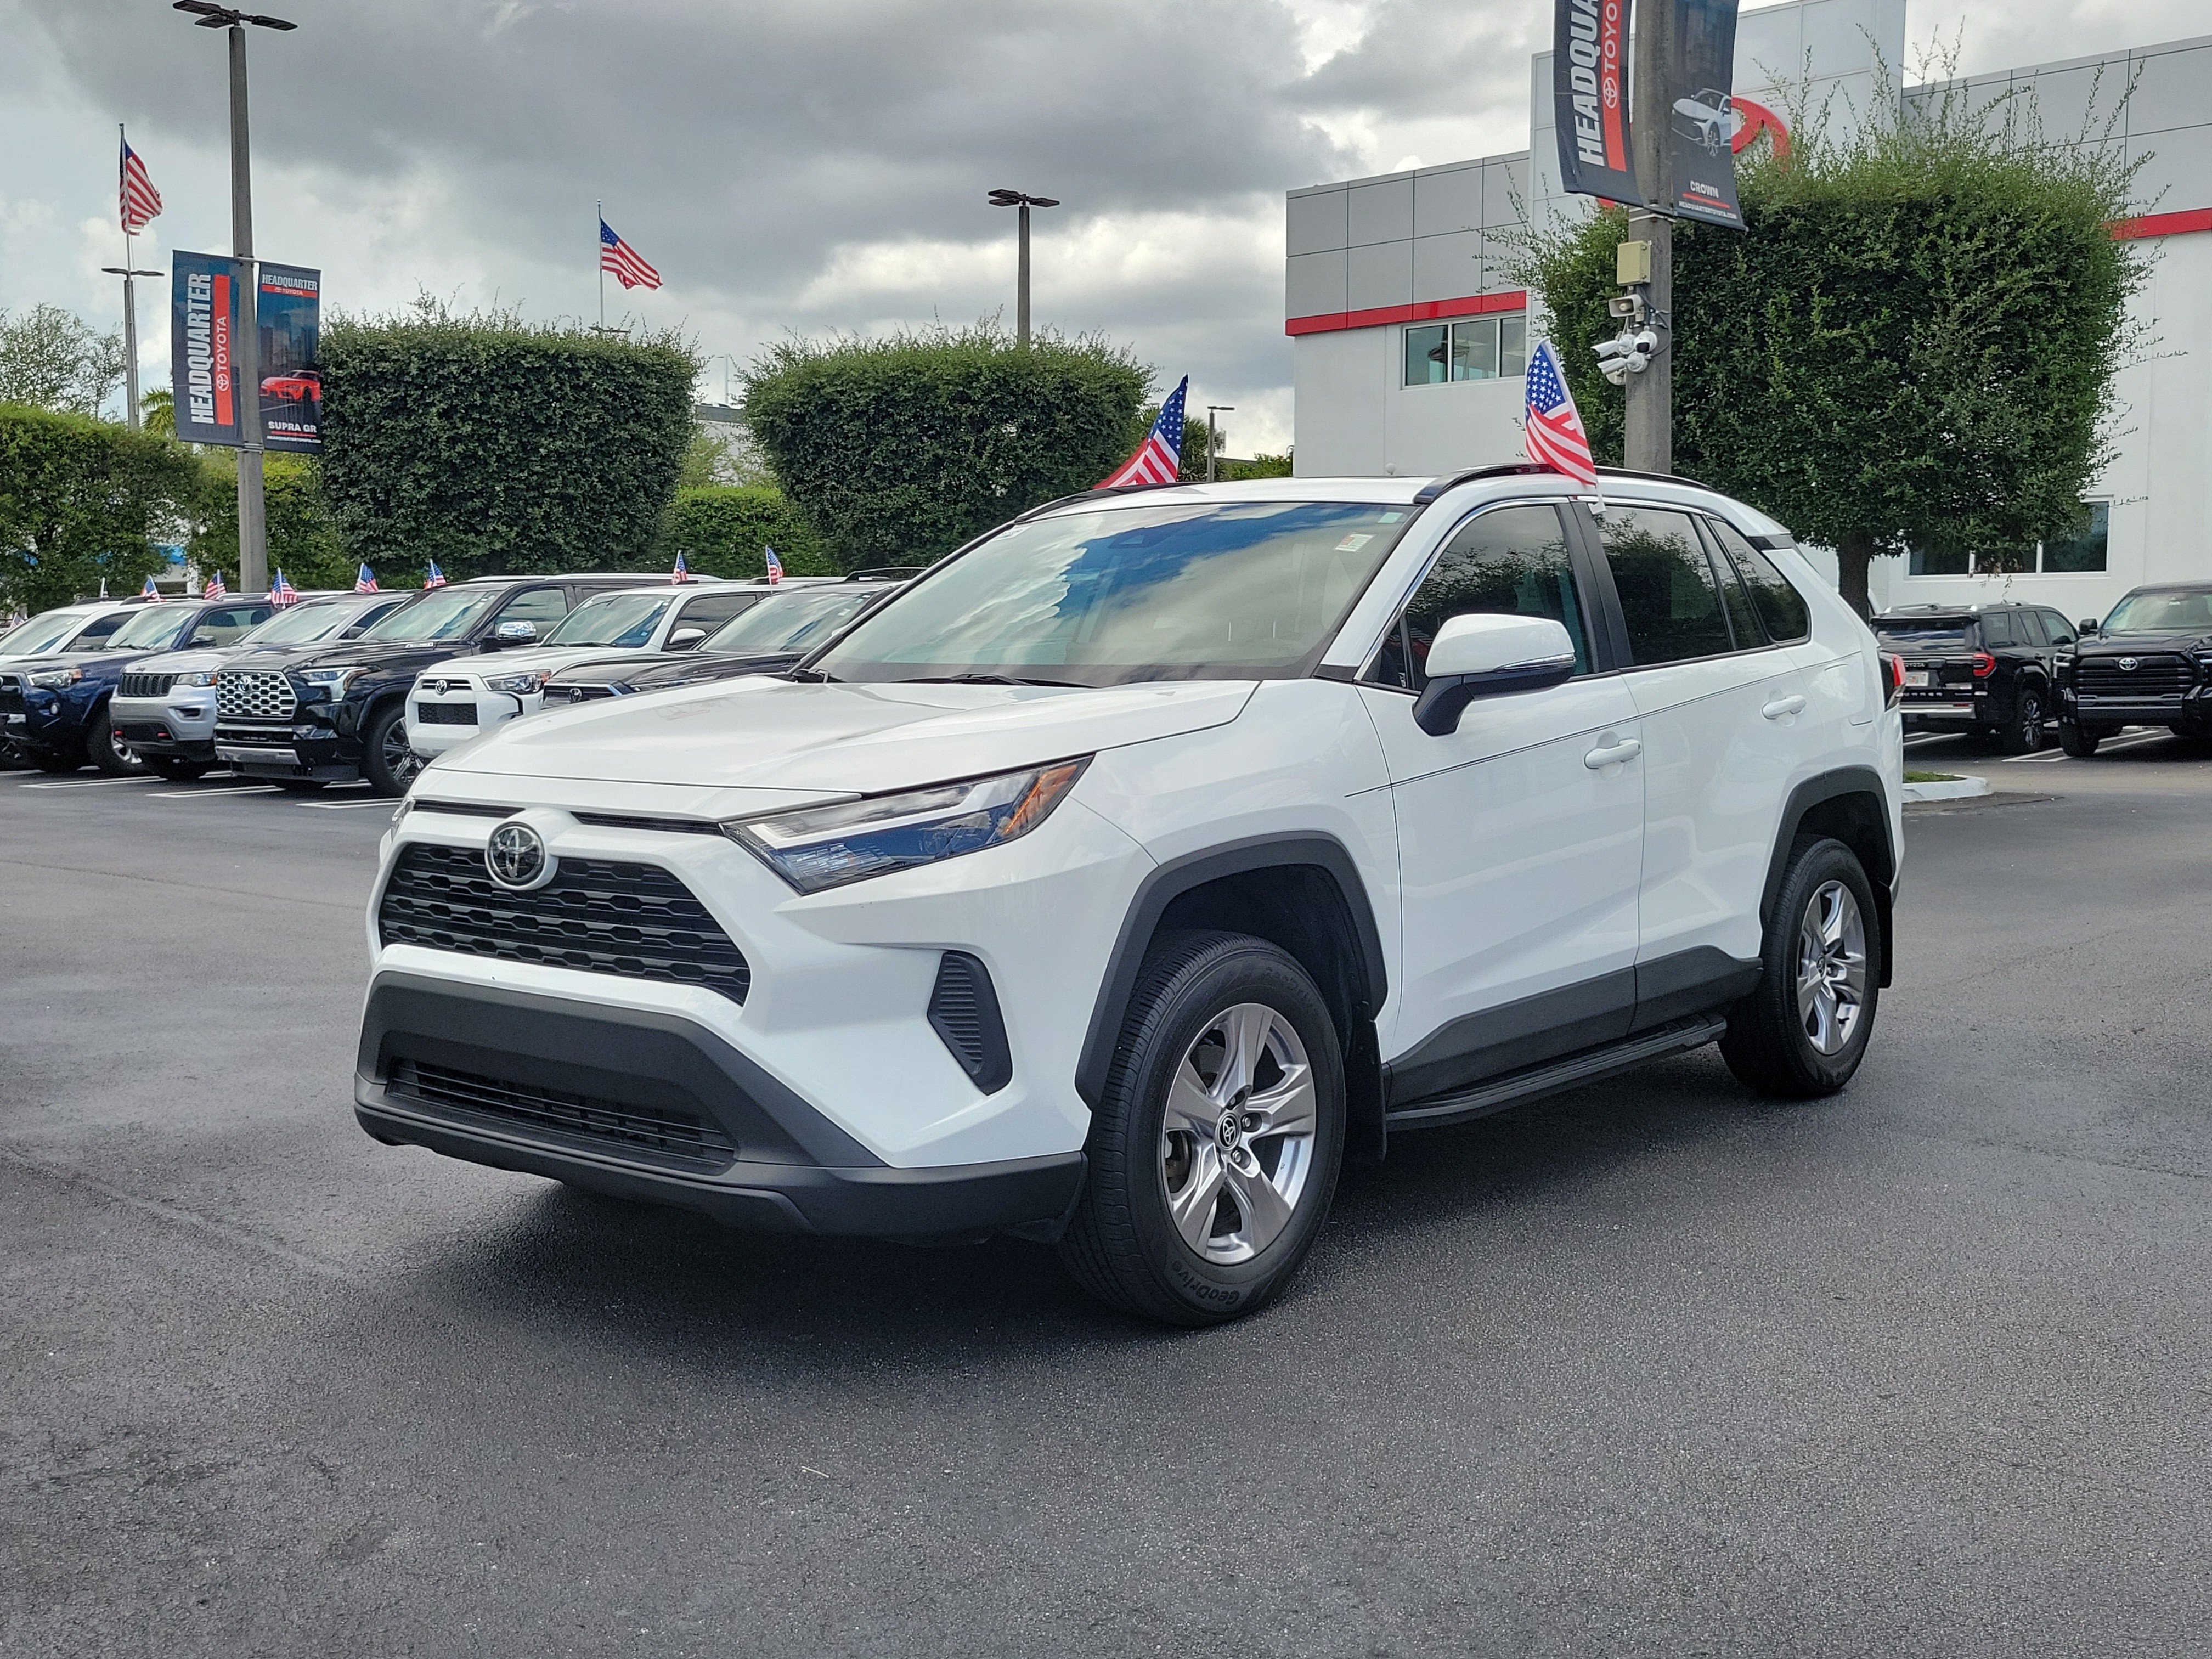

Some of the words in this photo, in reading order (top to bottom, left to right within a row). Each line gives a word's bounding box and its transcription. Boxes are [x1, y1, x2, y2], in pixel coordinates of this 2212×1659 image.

[1690, 180, 1719, 198] CROWN
[262, 273, 318, 291] HEADQUARTER
[188, 273, 215, 424] HEADQUARTER
[216, 315, 227, 372] TOYOTA
[268, 421, 302, 432] SUPRA
[303, 424, 317, 433] GR
